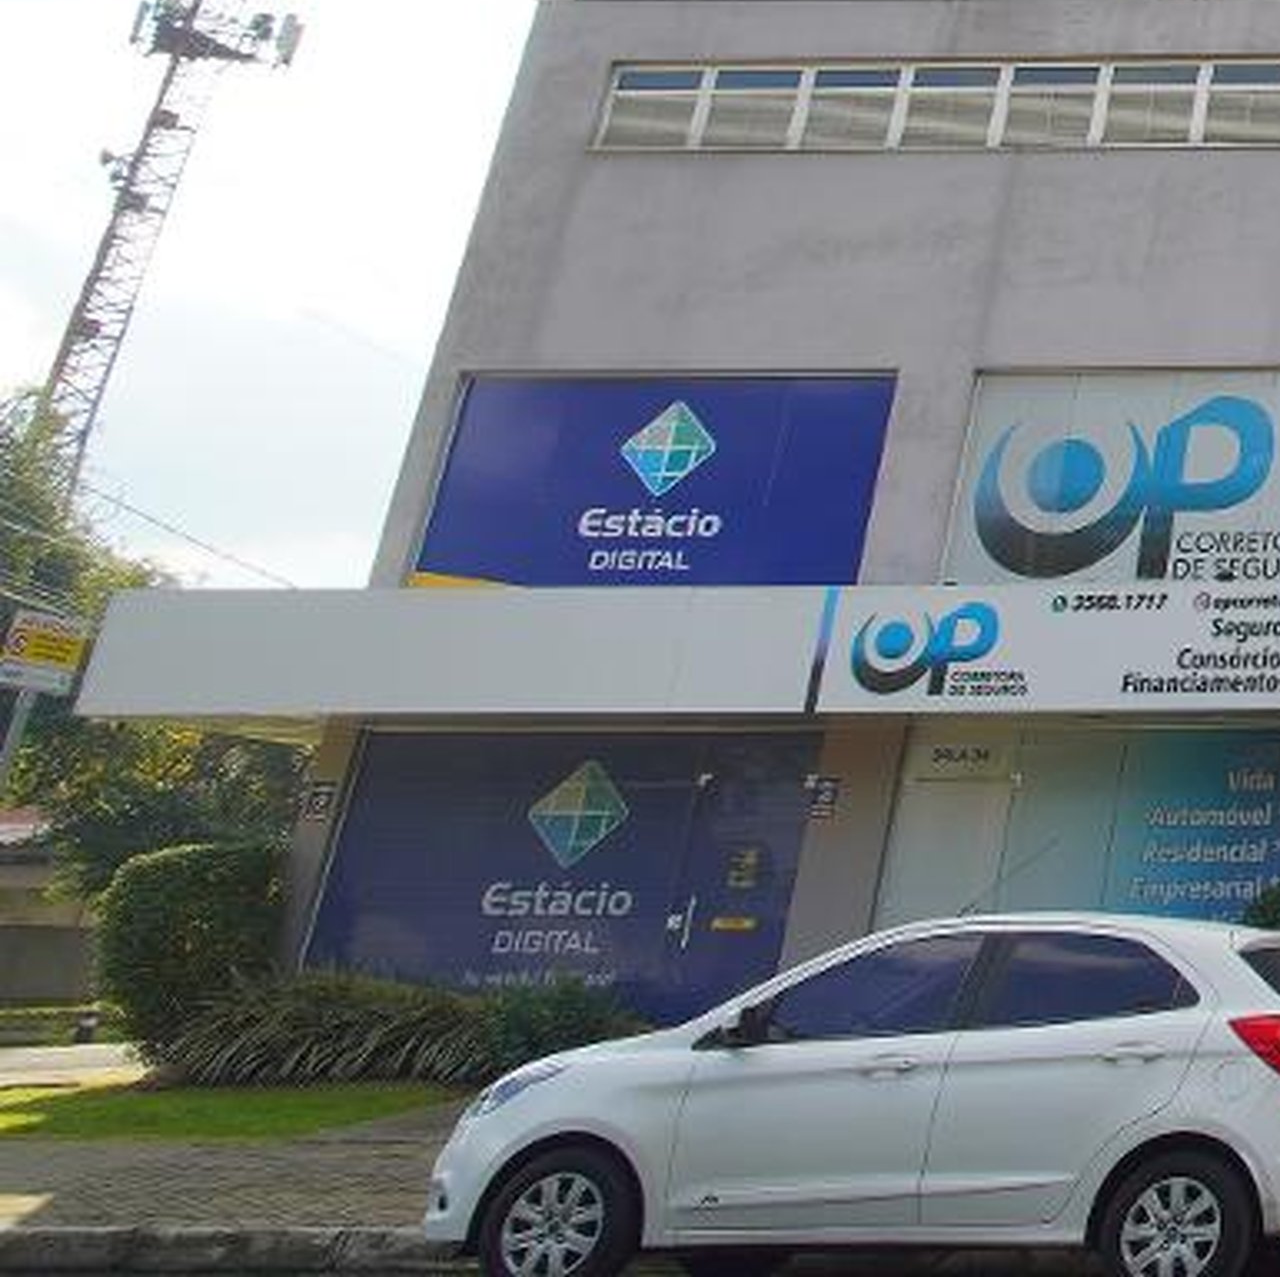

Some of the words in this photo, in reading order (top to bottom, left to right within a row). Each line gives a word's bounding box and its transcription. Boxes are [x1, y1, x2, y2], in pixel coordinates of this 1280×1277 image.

[578, 507, 722, 537] Estácio
[588, 549, 690, 571] DIGITAL
[1172, 558, 1207, 581] DE
[1227, 769, 1276, 792] Vida
[1146, 801, 1272, 826] Automóvel
[1142, 837, 1268, 863] Residencial
[481, 881, 634, 916] Estácio
[1130, 876, 1263, 903] Empresarial
[490, 929, 600, 955] DIGITAL
